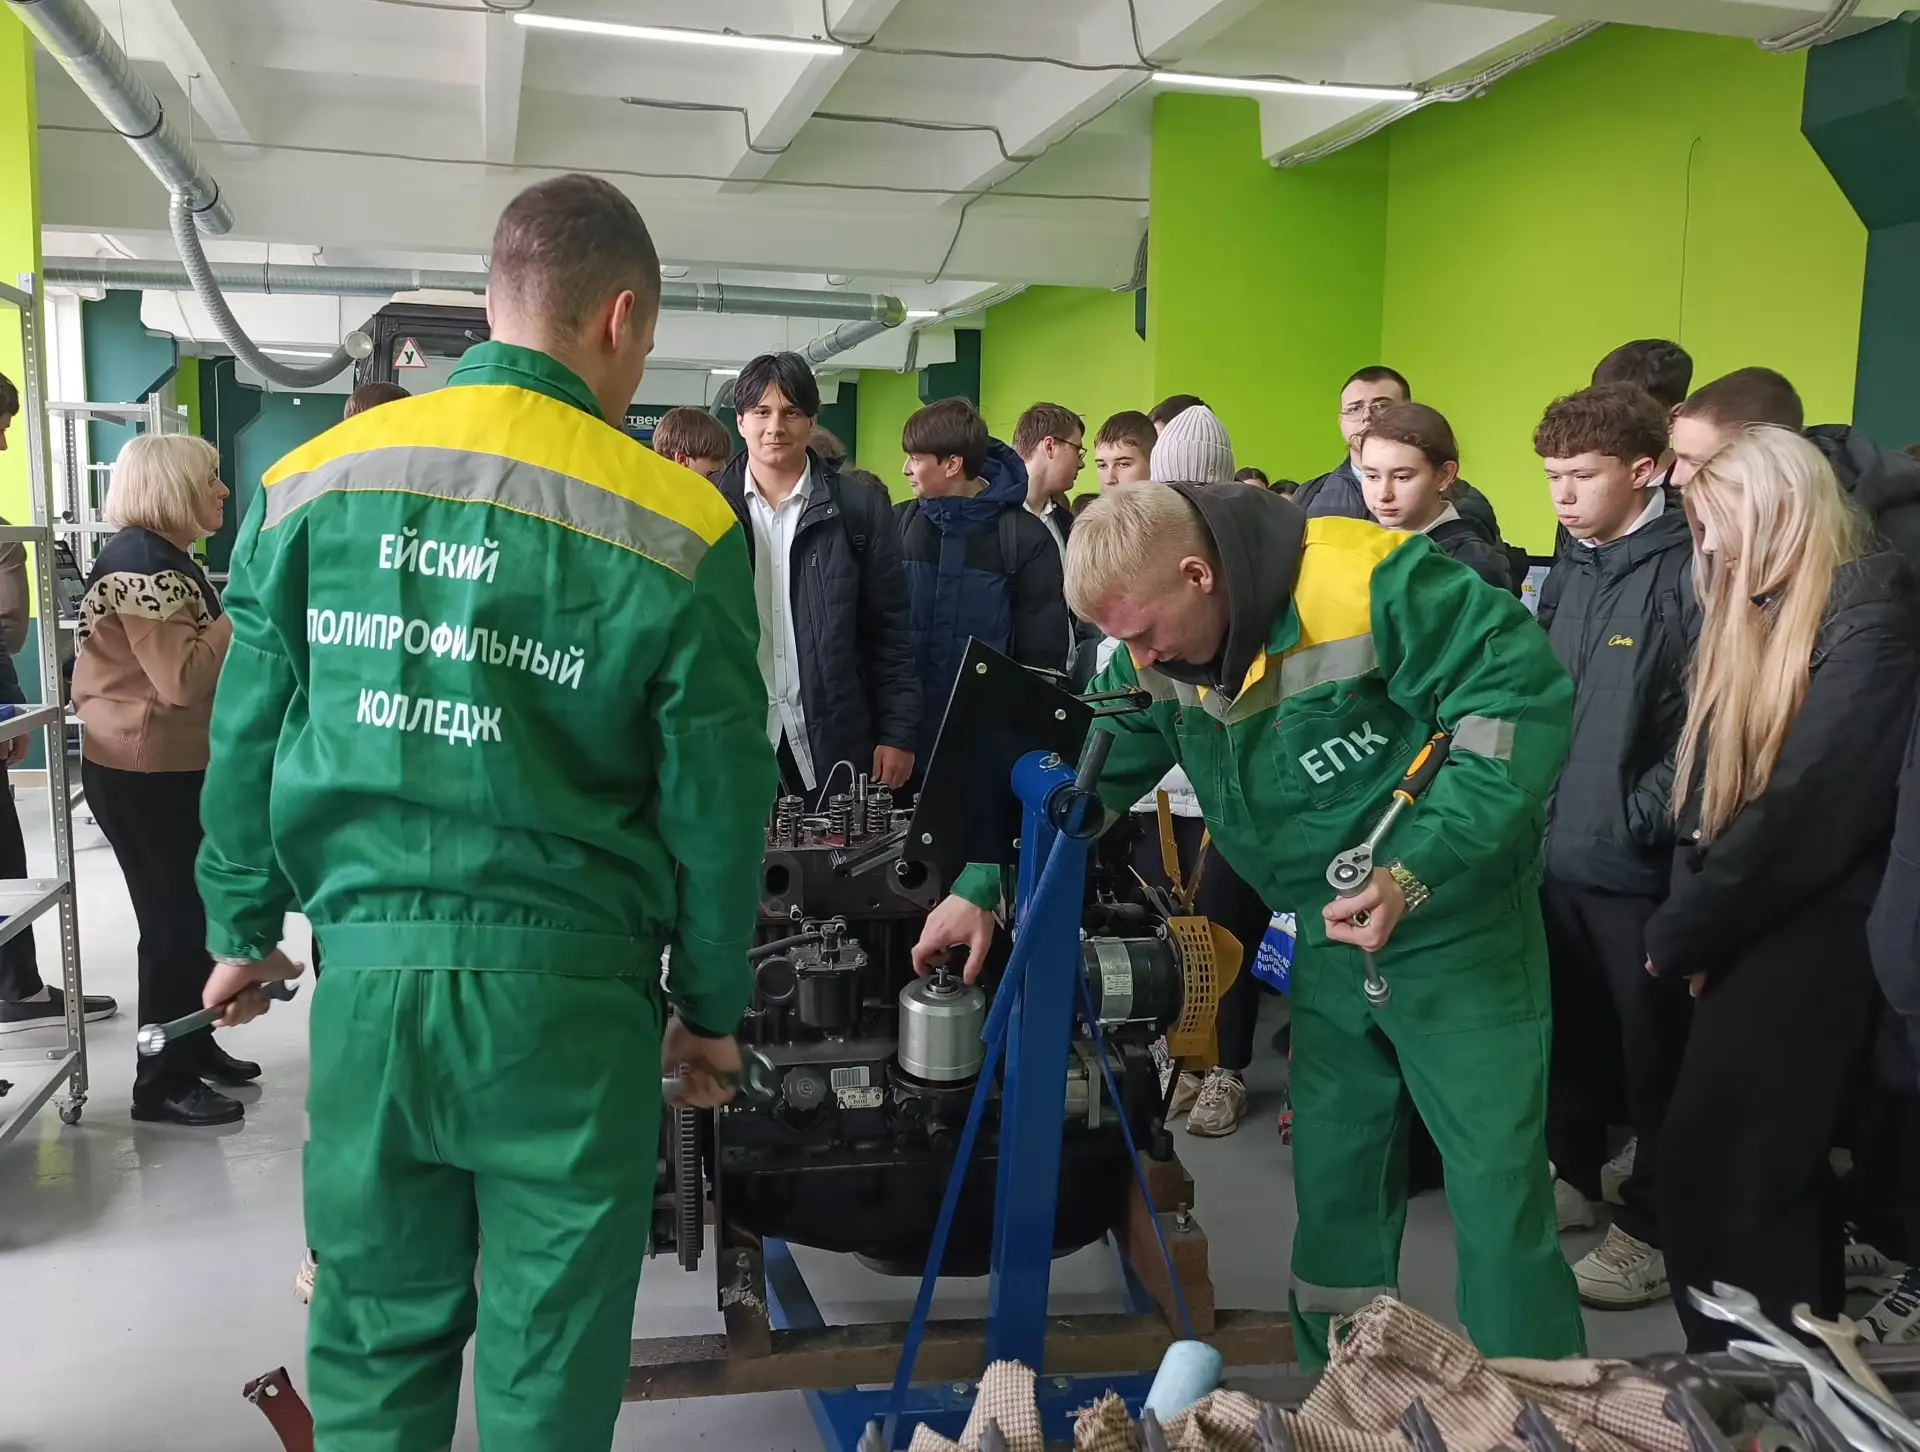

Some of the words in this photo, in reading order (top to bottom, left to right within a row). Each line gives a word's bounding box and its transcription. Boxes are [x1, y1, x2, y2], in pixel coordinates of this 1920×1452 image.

[378, 526, 500, 584] ЕЙСКИЙ
[306, 608, 585, 690] ПОЛИПРОФИЛЬНЫЙ
[356, 688, 502, 747] КОЛЛЕДЖ
[1298, 721, 1389, 784] ЕПК
